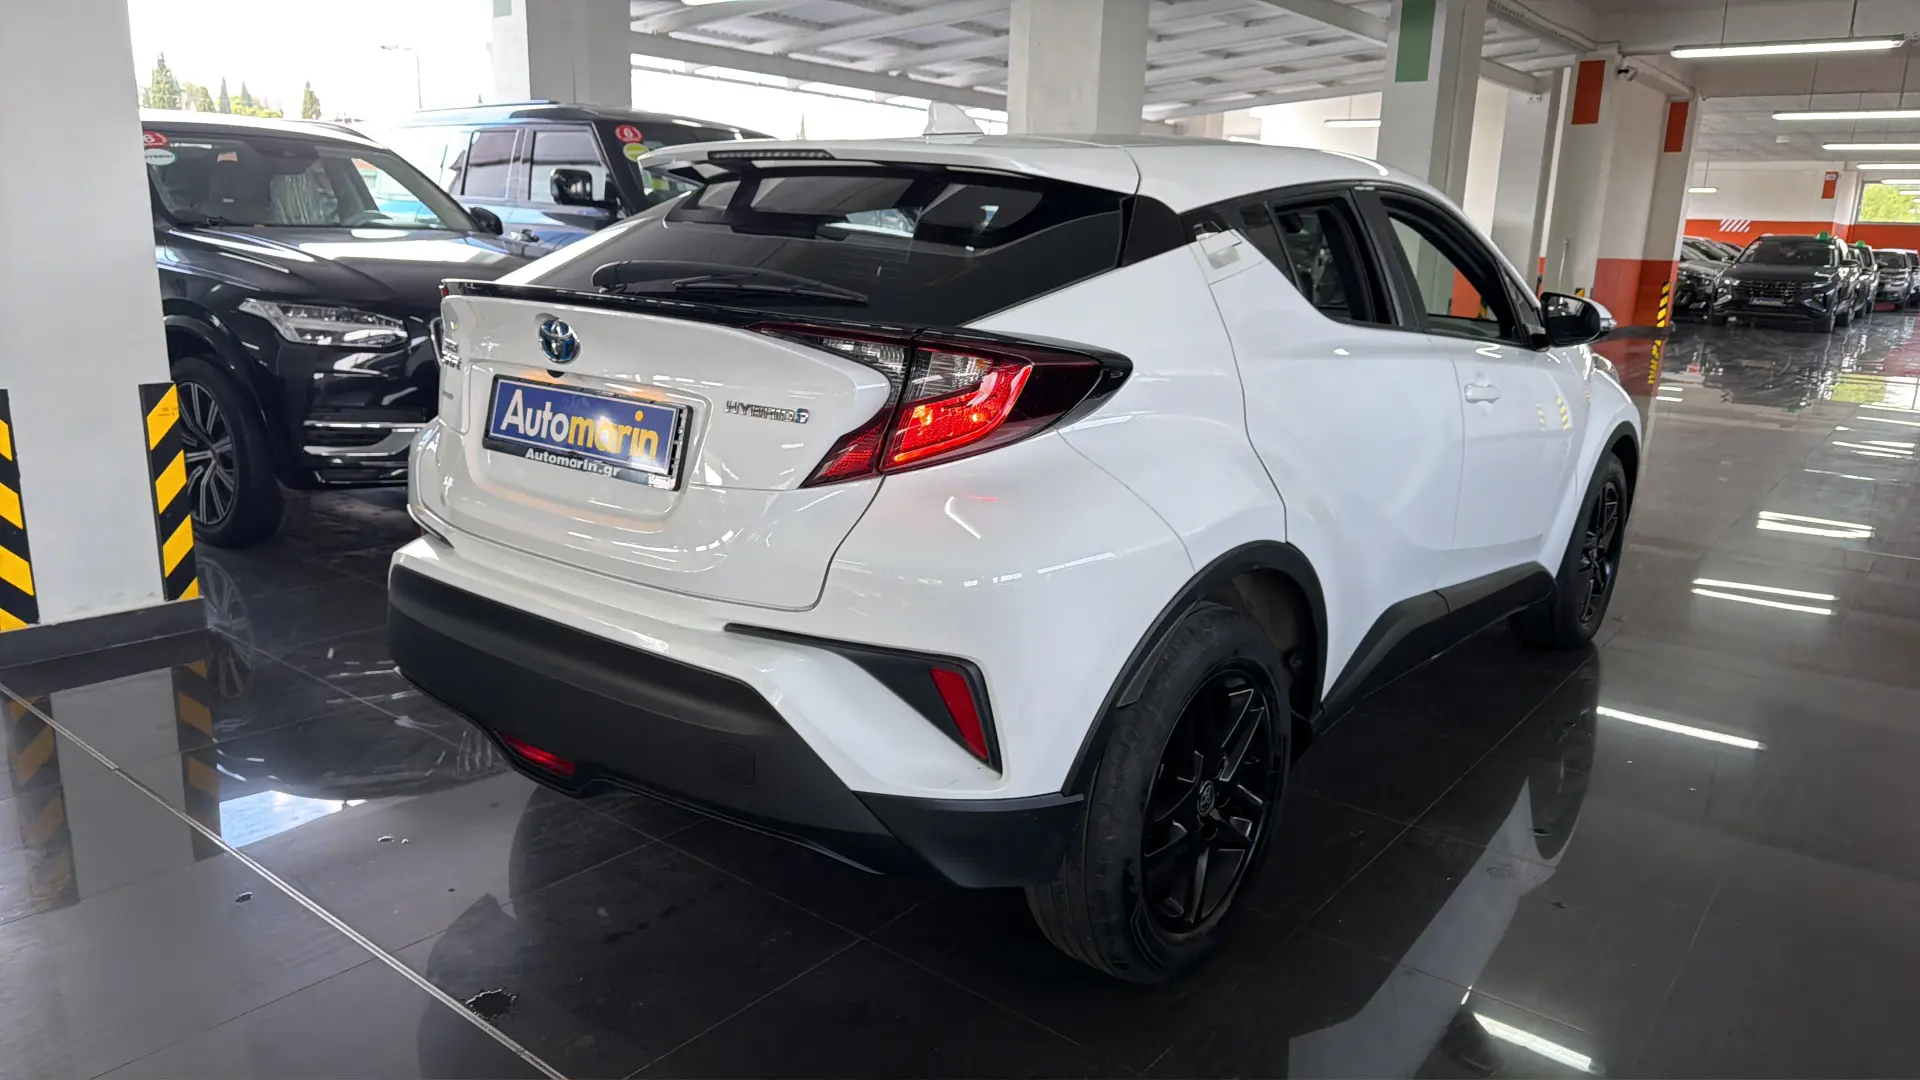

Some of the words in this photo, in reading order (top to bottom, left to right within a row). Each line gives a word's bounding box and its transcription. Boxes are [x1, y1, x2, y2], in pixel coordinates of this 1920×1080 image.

[501, 389, 659, 461] Automarin
[724, 400, 795, 422] HYBRID
[525, 448, 621, 477] Automarin.gr
